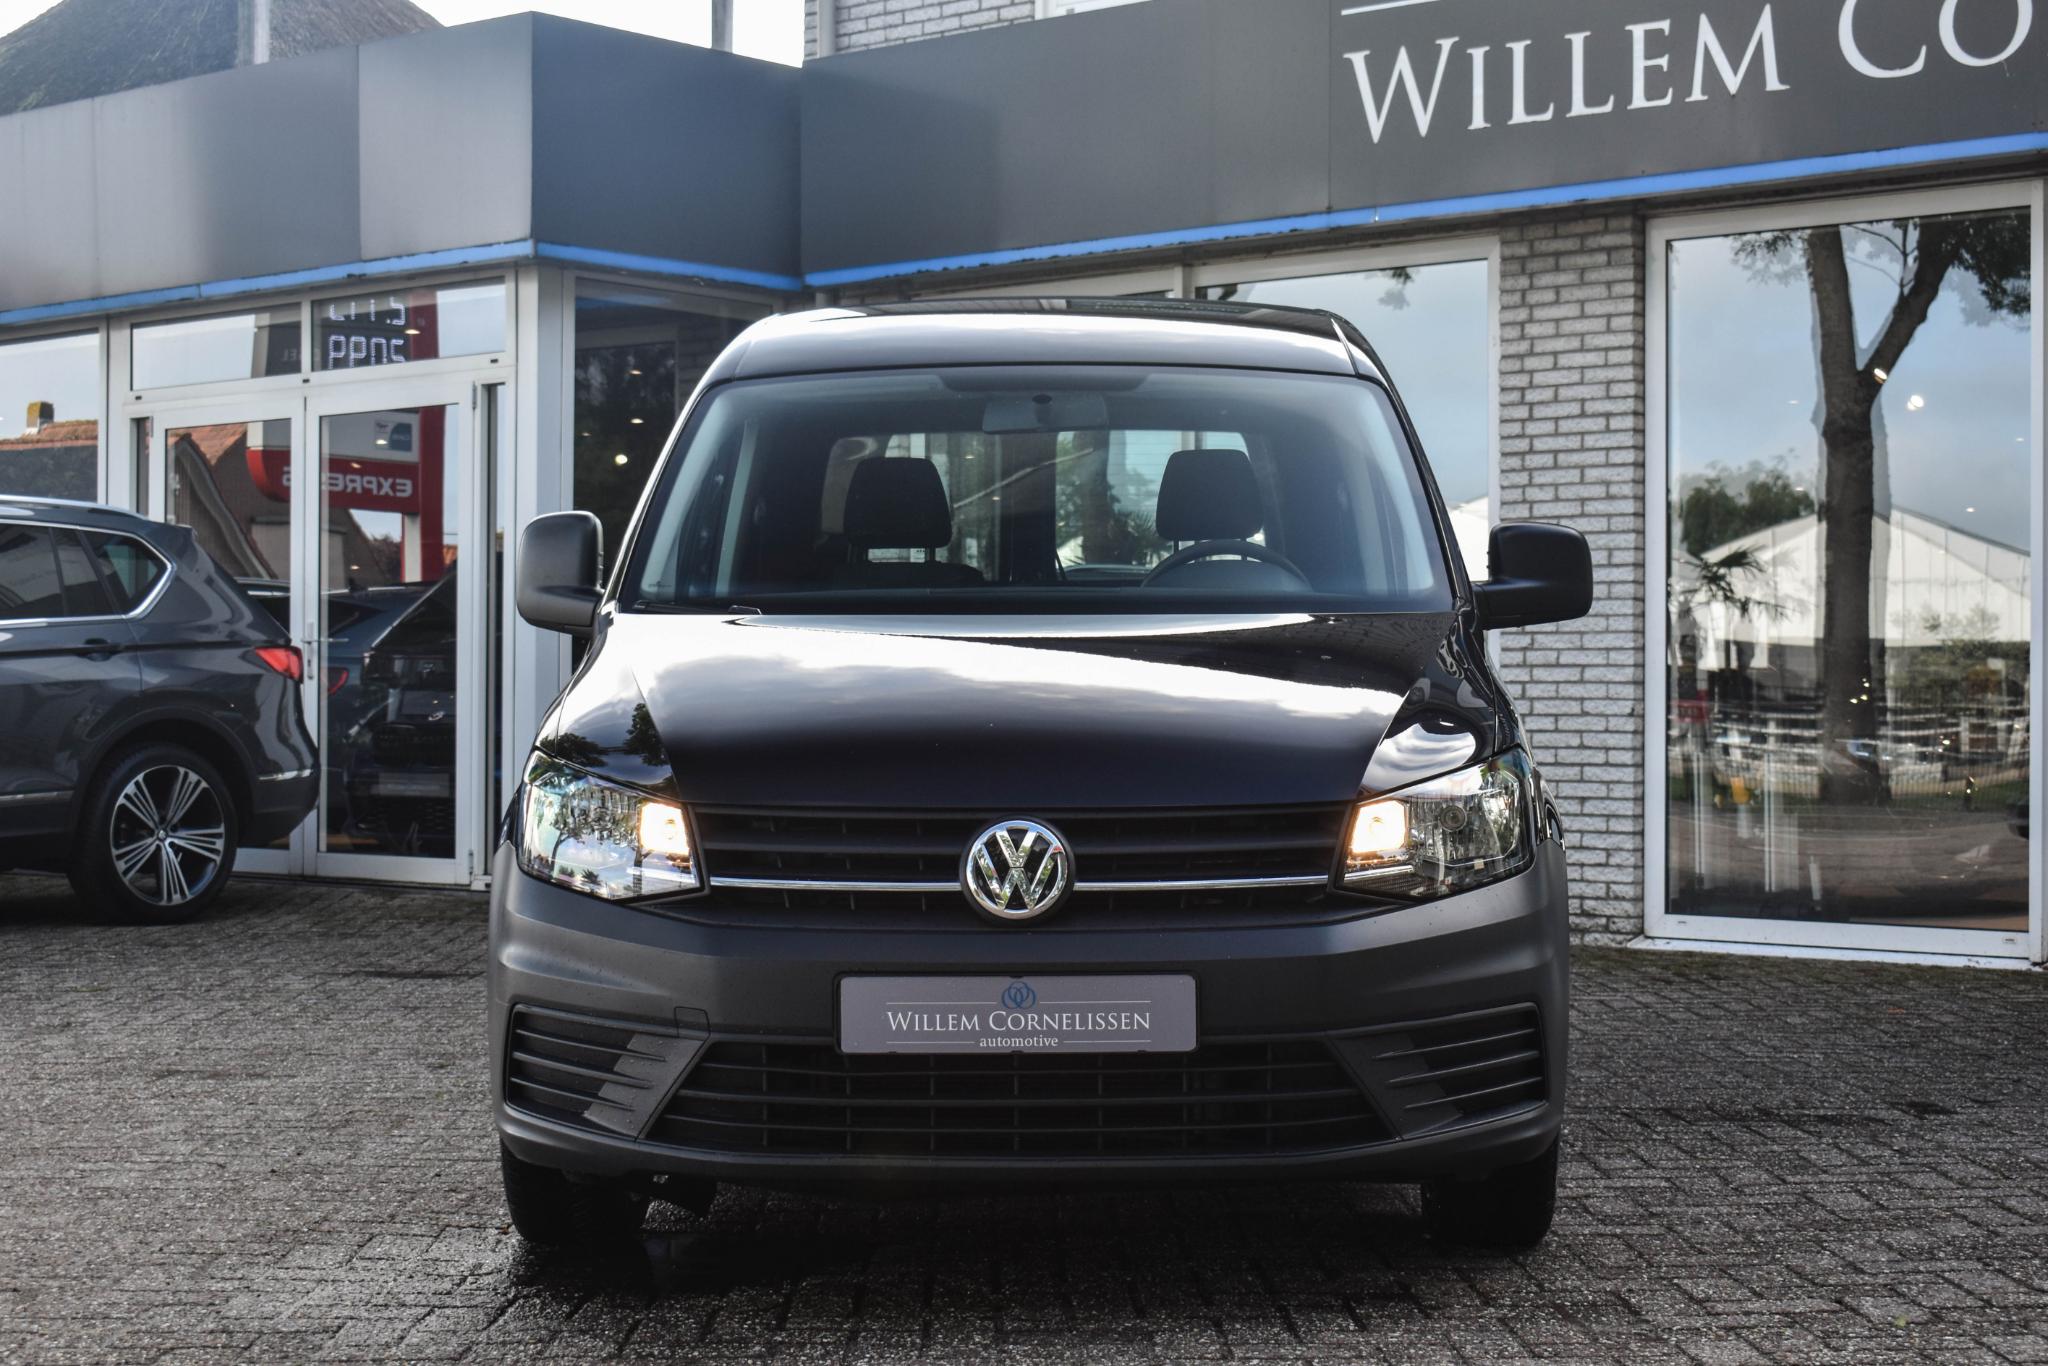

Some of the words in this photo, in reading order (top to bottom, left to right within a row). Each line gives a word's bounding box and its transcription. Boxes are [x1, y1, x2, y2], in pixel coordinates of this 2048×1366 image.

[1343, 3, 1790, 144] WILLEM
[1838, 0, 2033, 78] CO
[887, 1011, 980, 1031] WILLEM
[988, 1010, 1151, 1031] CORNELISSEN
[979, 1034, 1059, 1048] automotive
